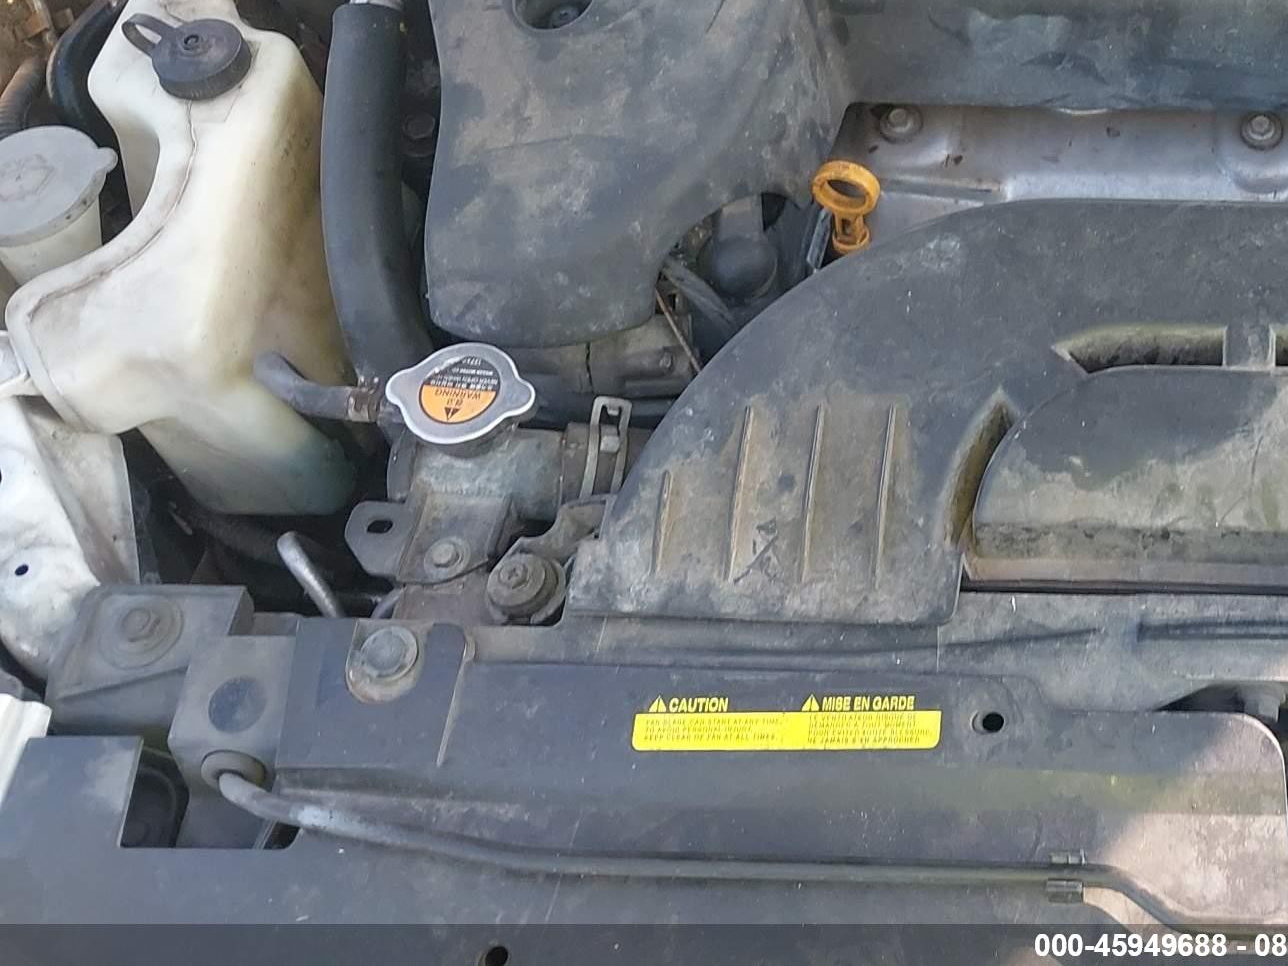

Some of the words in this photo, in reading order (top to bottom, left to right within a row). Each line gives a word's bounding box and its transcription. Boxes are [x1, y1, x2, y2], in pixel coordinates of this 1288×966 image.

[435, 389, 480, 400] WARNING
[668, 697, 729, 713] CAUTION
[821, 696, 852, 711] MISE
[853, 696, 871, 711] EN
[872, 696, 916, 711] GARDE
